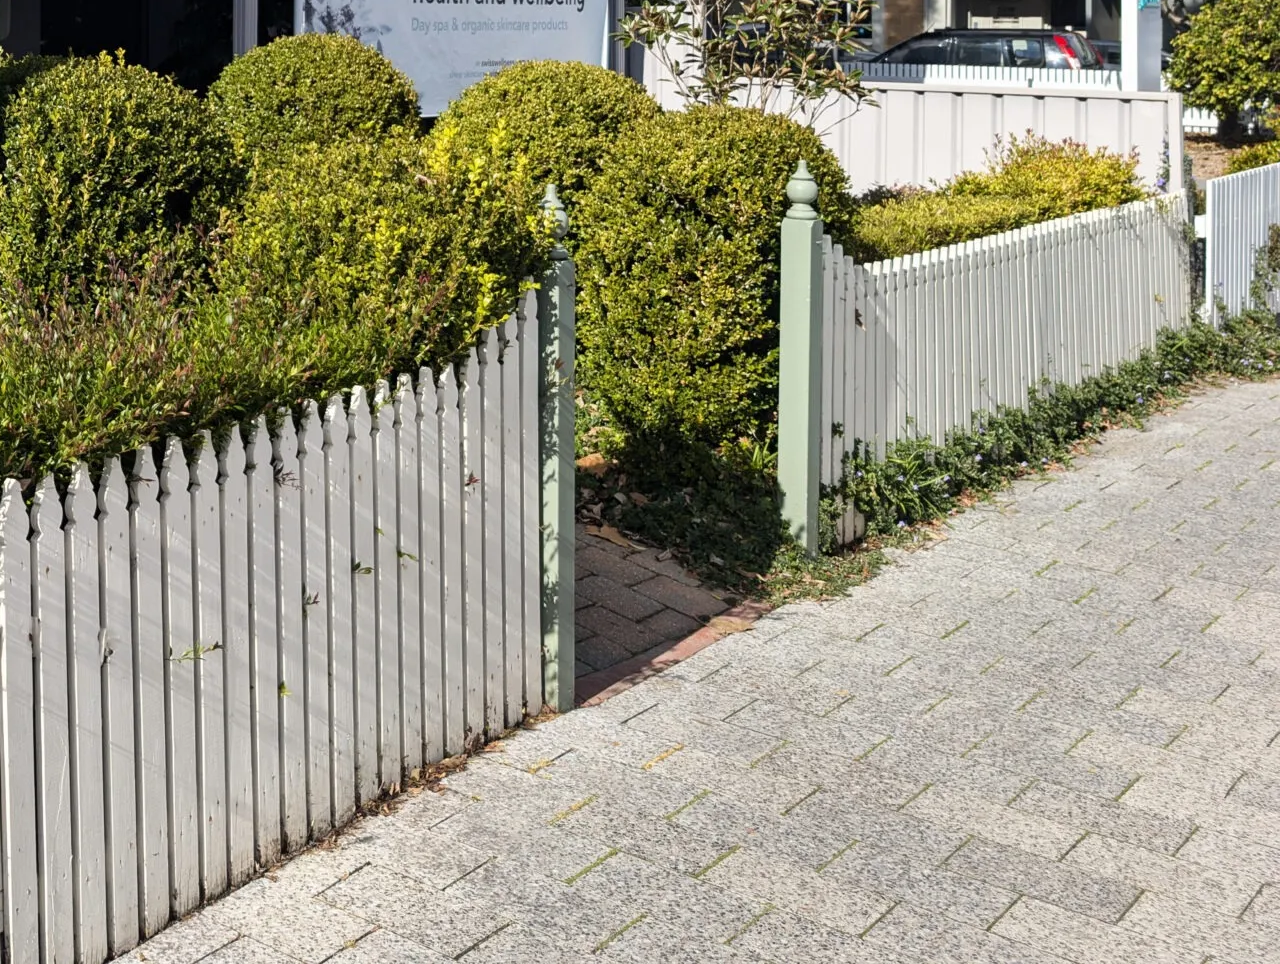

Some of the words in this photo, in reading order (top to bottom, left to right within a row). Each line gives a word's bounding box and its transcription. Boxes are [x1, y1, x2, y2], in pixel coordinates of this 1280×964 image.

[411, 17, 431, 35] Day
[432, 21, 449, 34] spa
[451, 17, 459, 32] &
[461, 17, 495, 35] organic
[496, 17, 530, 32] skincare
[532, 17, 569, 36] products
